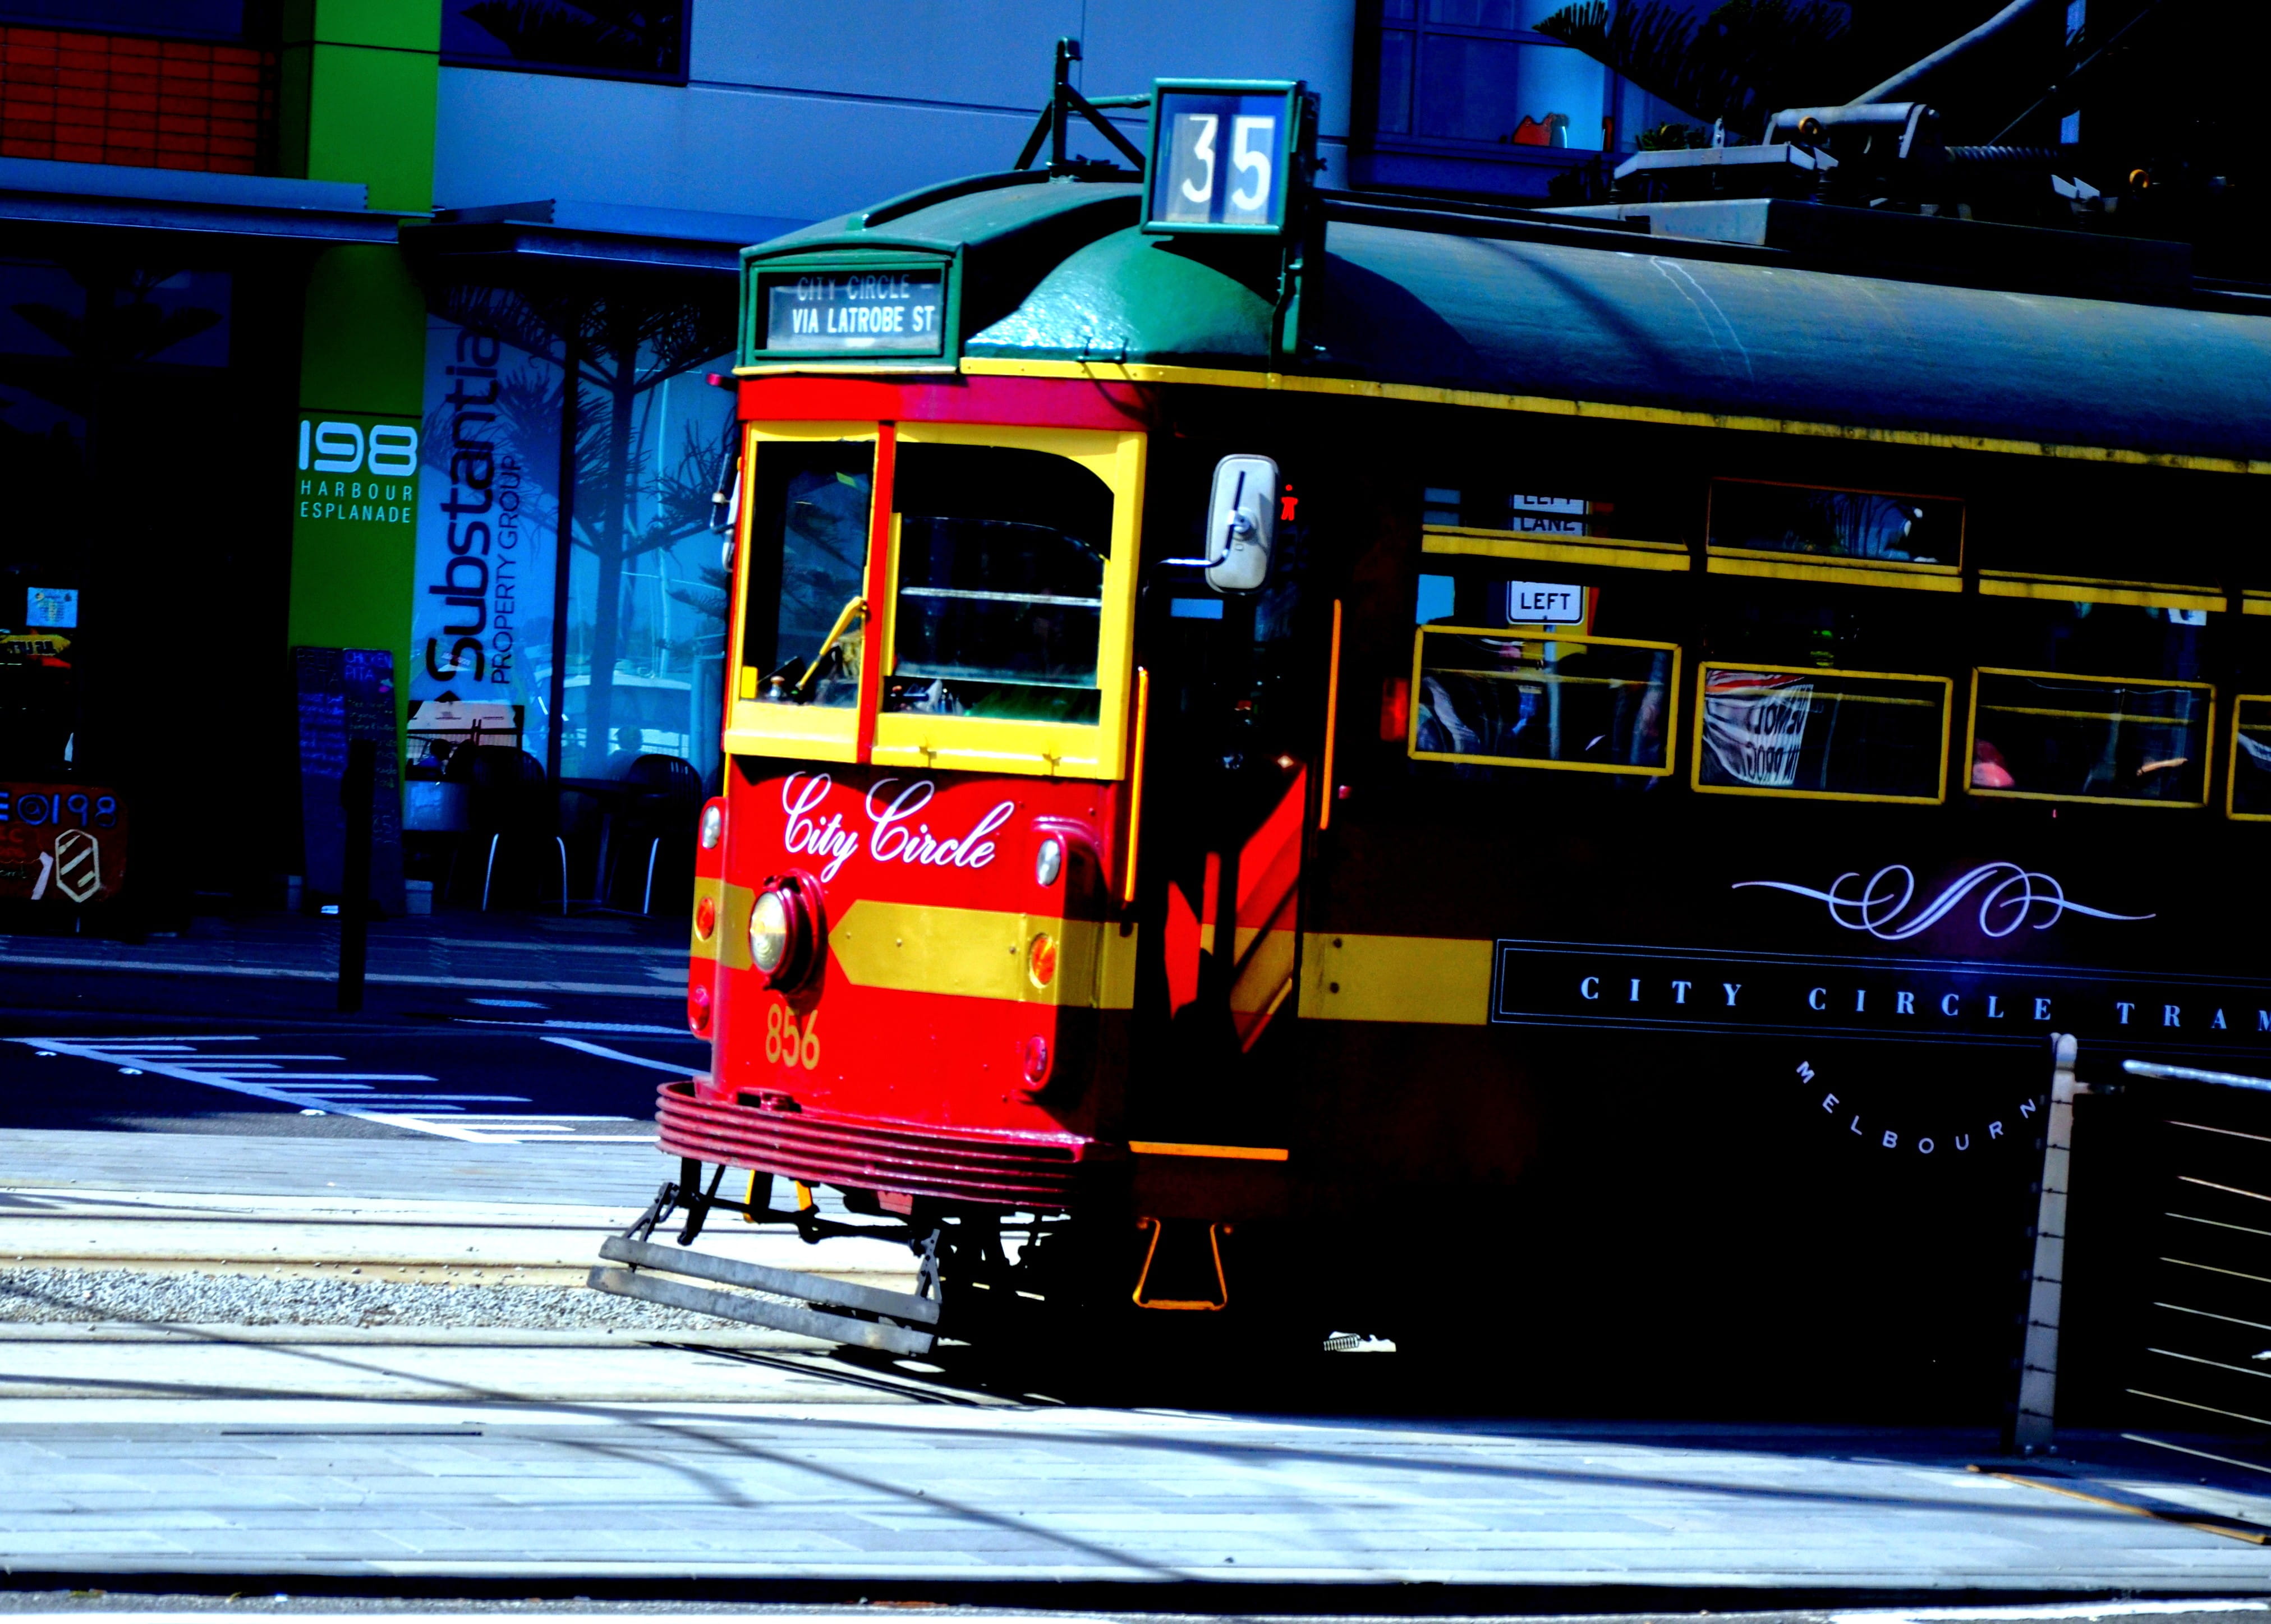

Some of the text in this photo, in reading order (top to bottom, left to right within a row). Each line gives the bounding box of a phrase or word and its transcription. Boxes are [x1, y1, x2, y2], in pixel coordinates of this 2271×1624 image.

[1182, 113, 1276, 210] 35
[797, 274, 911, 301] CITY CIRCLE
[792, 305, 936, 333] VIA LATROBE ST
[298, 420, 419, 477] 198
[301, 480, 413, 502] HARBOUR
[301, 502, 411, 523] ESPLANADE
[426, 328, 500, 682] Substantia
[491, 455, 521, 684] PROPERTY GROUP
[1521, 592, 1571, 610] LEFT
[781, 771, 1015, 883] City Circle
[1580, 976, 1742, 1007] CITY
[1809, 987, 2052, 1021] CIRCLE
[765, 1002, 821, 1070] 856
[1795, 1060, 2037, 1156] MELBOURN
